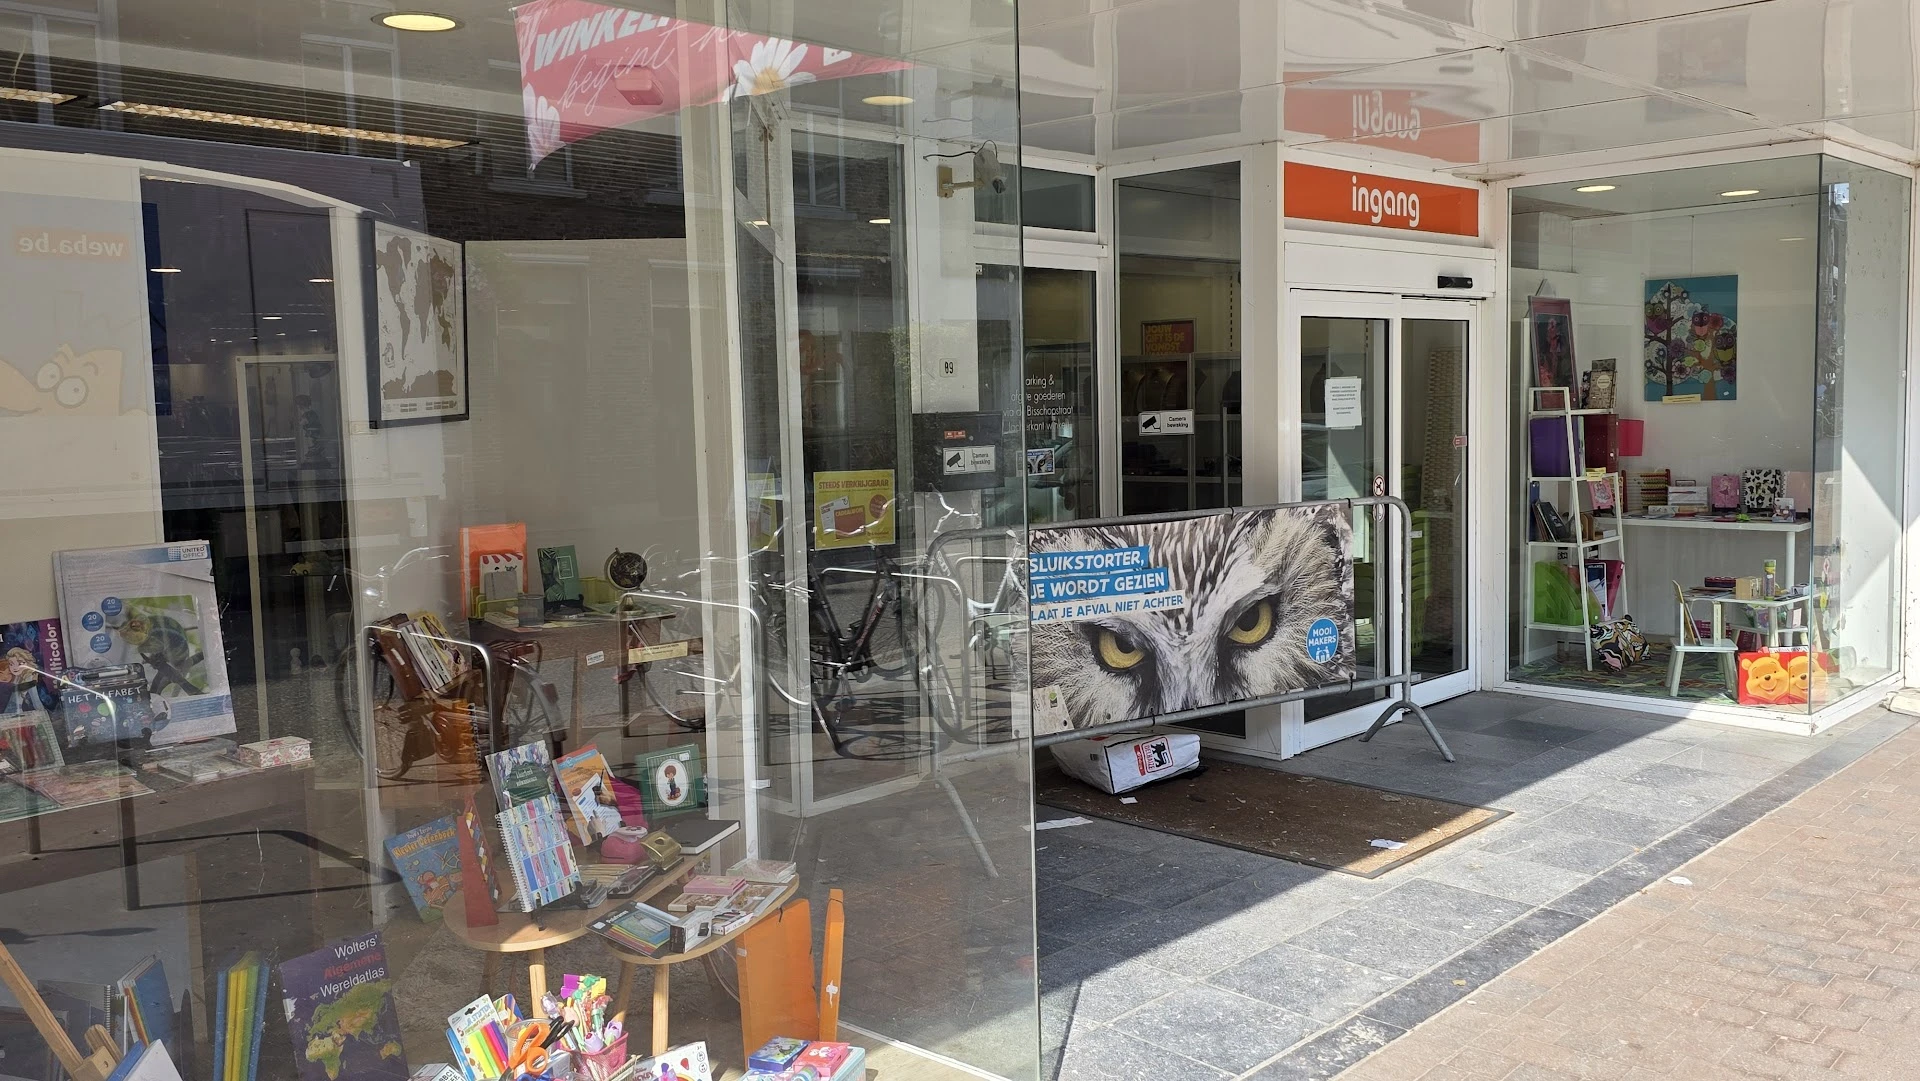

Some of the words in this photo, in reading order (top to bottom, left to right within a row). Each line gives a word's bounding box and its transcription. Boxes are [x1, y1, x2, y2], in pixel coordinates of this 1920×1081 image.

[1352, 175, 1420, 228] ingang
[1025, 374, 1047, 389] arking
[1048, 374, 1055, 386] &
[1034, 389, 1066, 404] goederen
[819, 481, 840, 490] STEEDS
[841, 479, 889, 489] VERKRIJGBAAR
[1030, 550, 1144, 574] SLUIKSTORTER,
[1030, 583, 1045, 599] JE
[1050, 577, 1110, 597] WORDT
[1114, 571, 1166, 592] GEZIEN
[1031, 609, 1059, 621] LAAT
[1061, 606, 1073, 618] JE
[1076, 603, 1113, 617] AFVAL
[1115, 600, 1140, 613] NIET
[1143, 594, 1184, 610] ACHTER
[1308, 635, 1336, 647] MAKERS
[1312, 626, 1332, 637] MOOI
[68, 694, 90, 704] HET
[95, 687, 142, 700] ALFABET
[334, 935, 378, 959] Wolters'
[324, 951, 383, 980] Algemene
[320, 967, 385, 998] Wereldatlas
